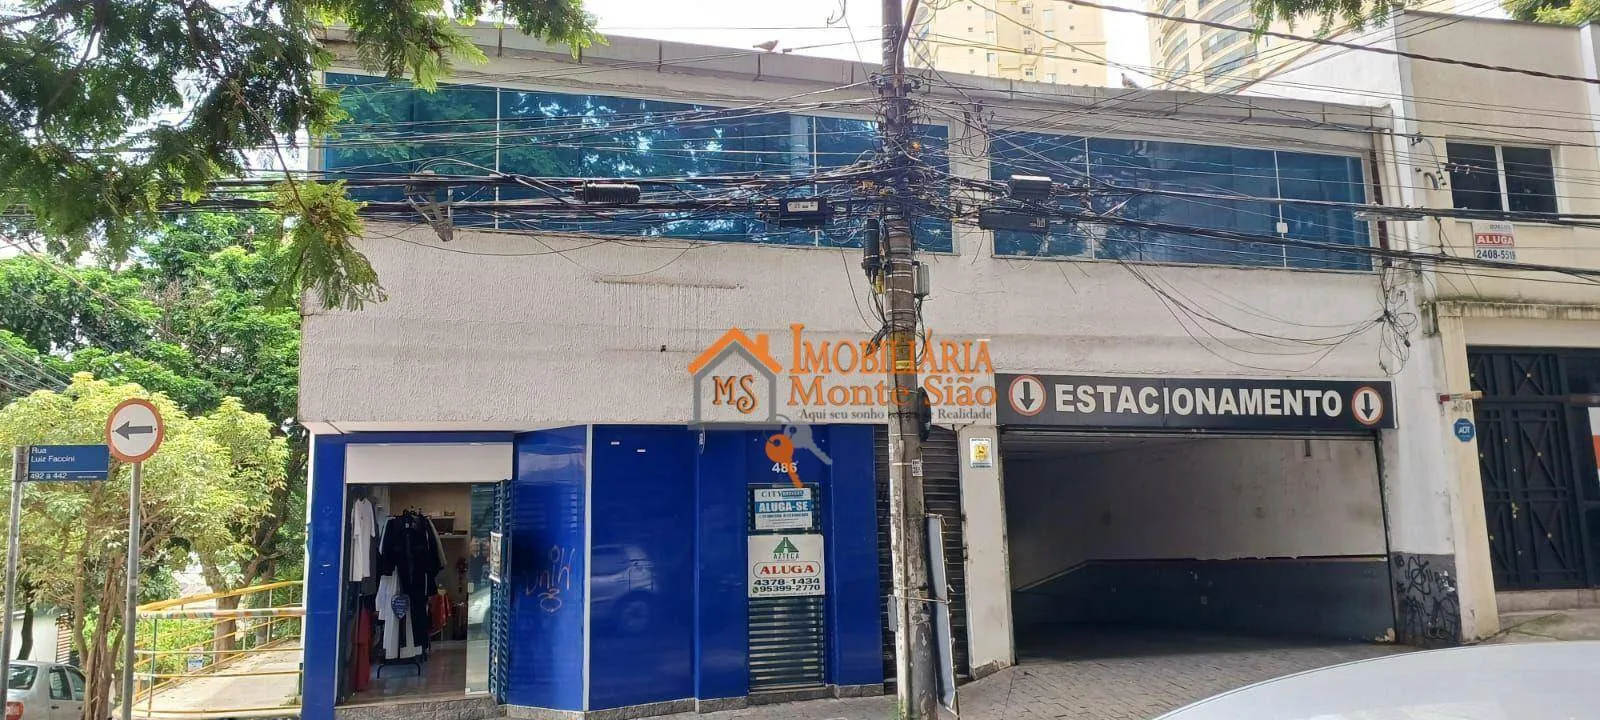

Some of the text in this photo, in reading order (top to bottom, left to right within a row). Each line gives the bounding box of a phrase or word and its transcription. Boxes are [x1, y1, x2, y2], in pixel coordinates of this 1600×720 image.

[1477, 235, 1513, 244] ALUGA
[1054, 383, 1343, 417] ESTACIONAMENTO
[48, 455, 75, 463] Faccini
[771, 462, 798, 473] 486
[758, 501, 809, 512] ALUGA-SE
[760, 565, 814, 575] ALUGA
[759, 584, 821, 593] 95399-2770
